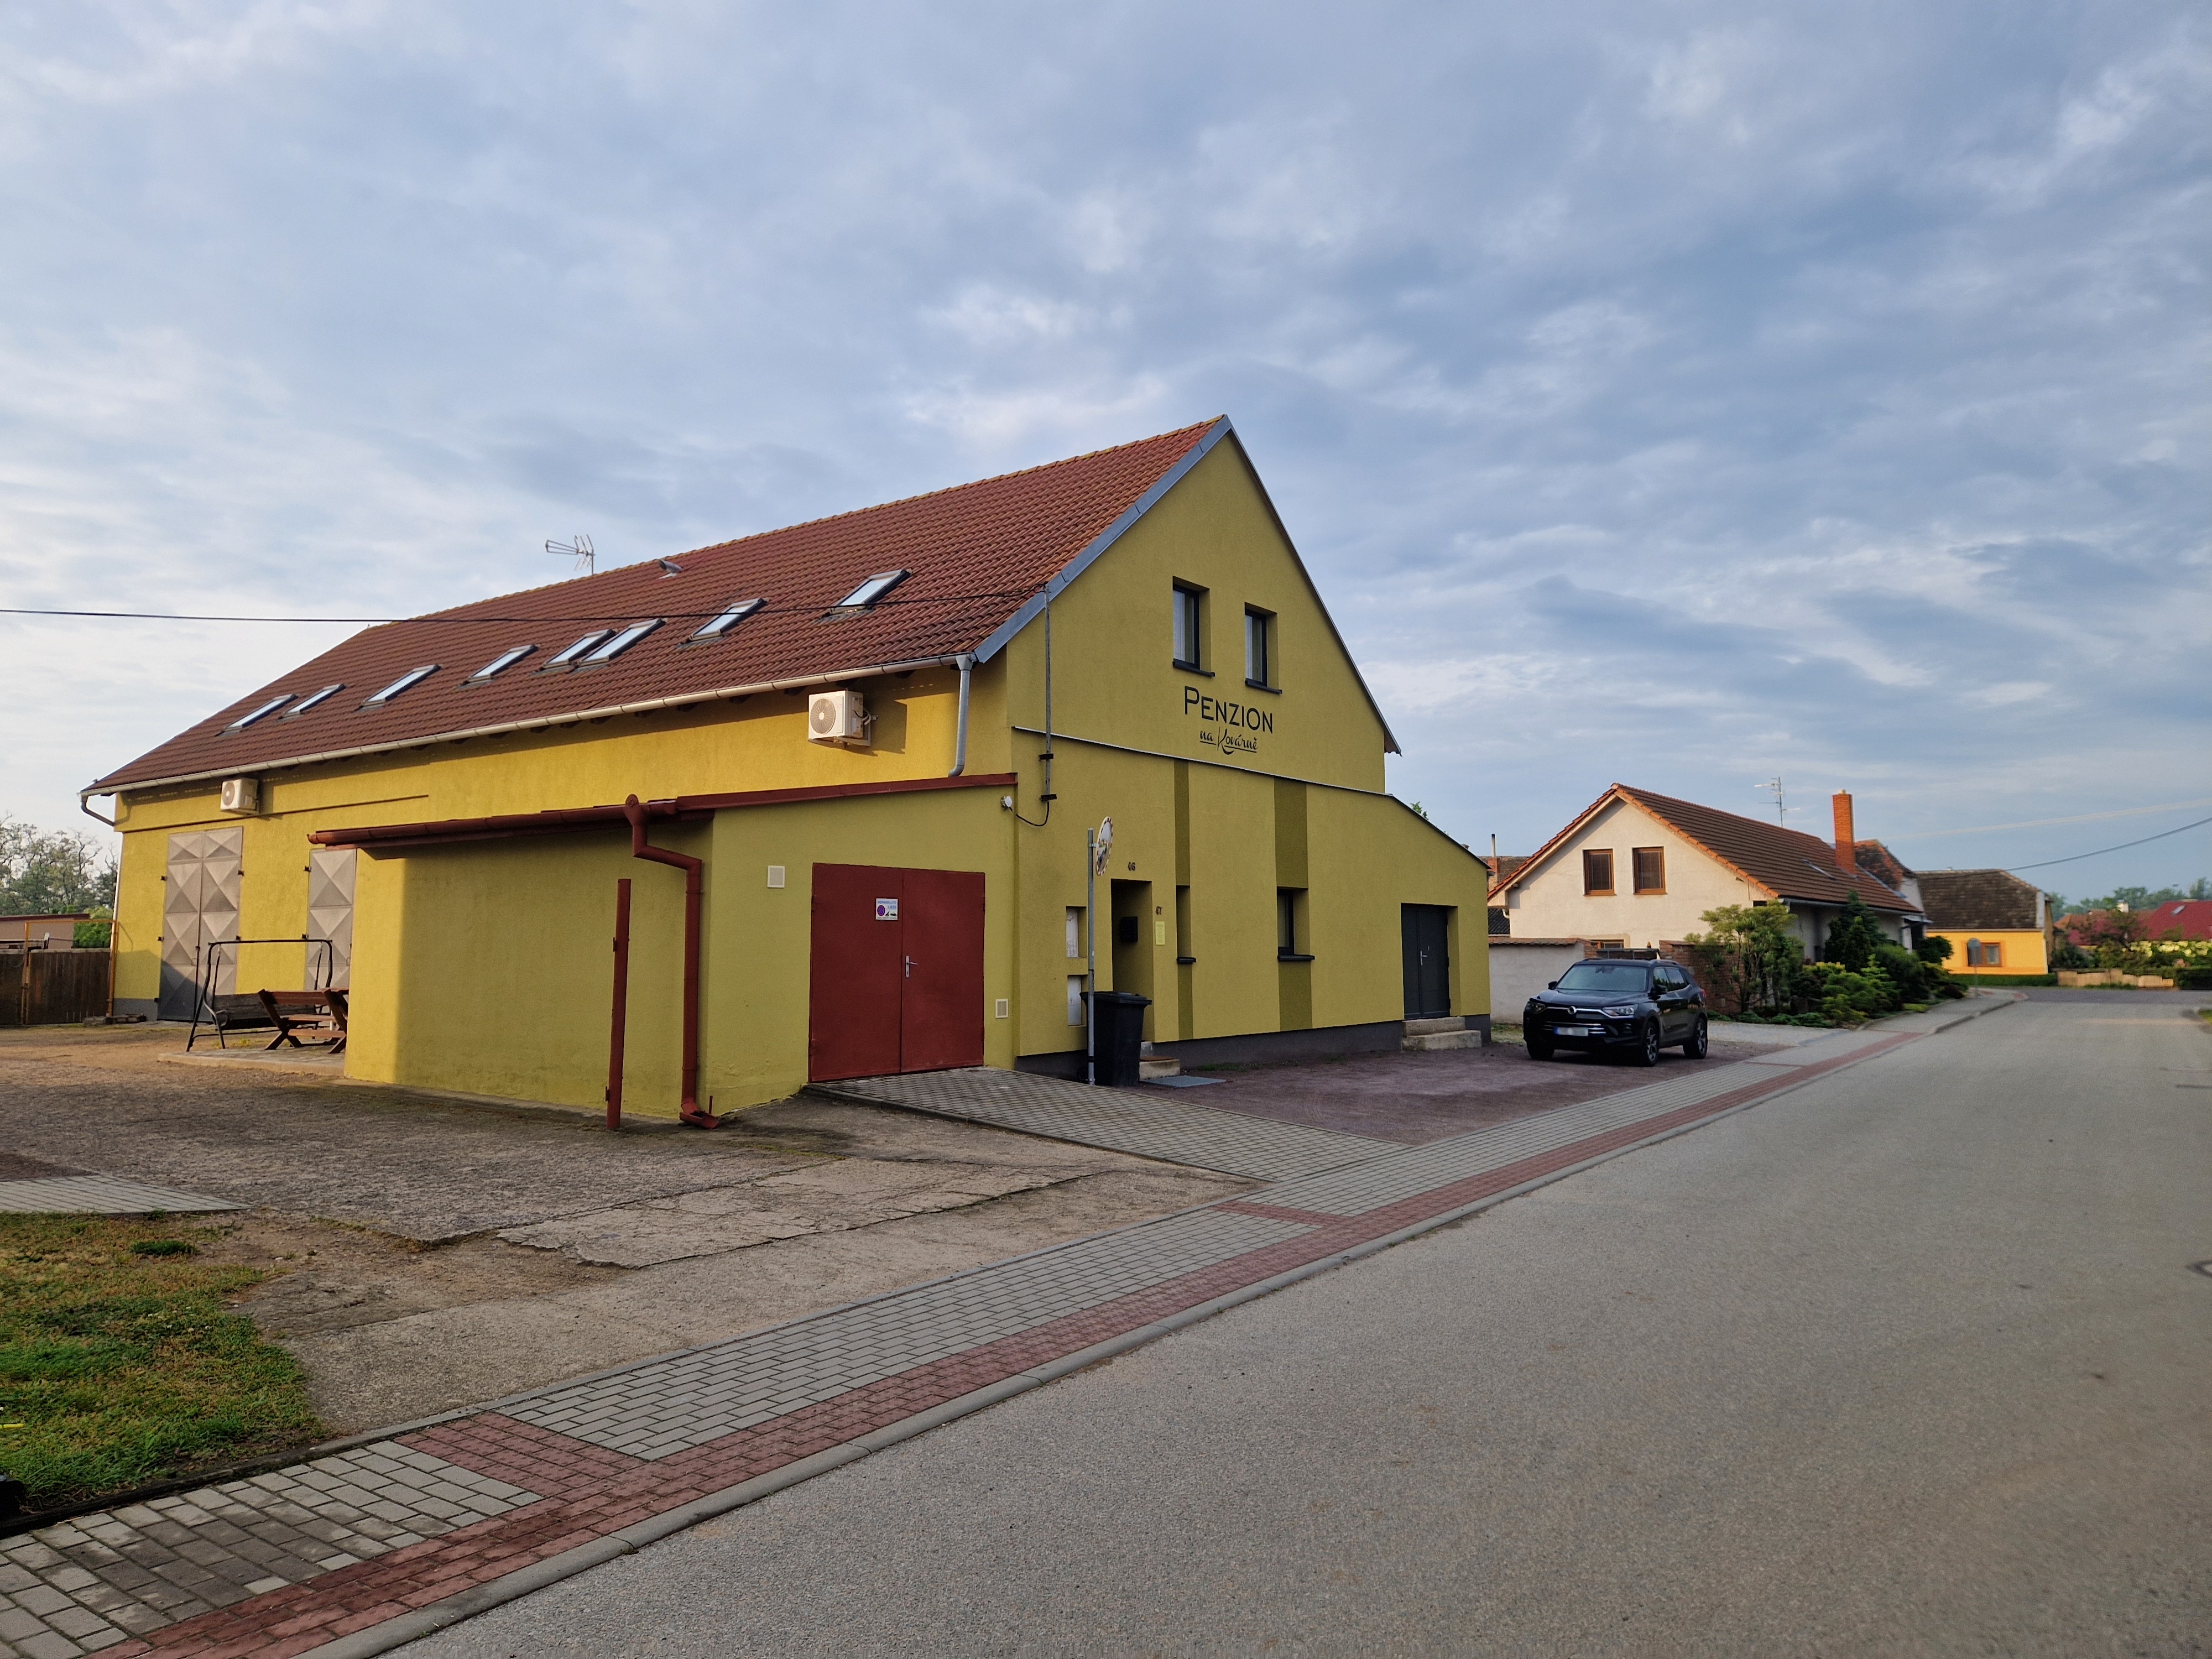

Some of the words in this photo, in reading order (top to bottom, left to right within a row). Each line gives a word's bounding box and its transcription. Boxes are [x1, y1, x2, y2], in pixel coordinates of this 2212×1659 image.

[1185, 685, 1272, 734] PENZION
[1200, 730, 1214, 742] na
[1217, 726, 1258, 755] Kovárně
[1128, 862, 1135, 871] 46
[1155, 906, 1162, 915] 47
